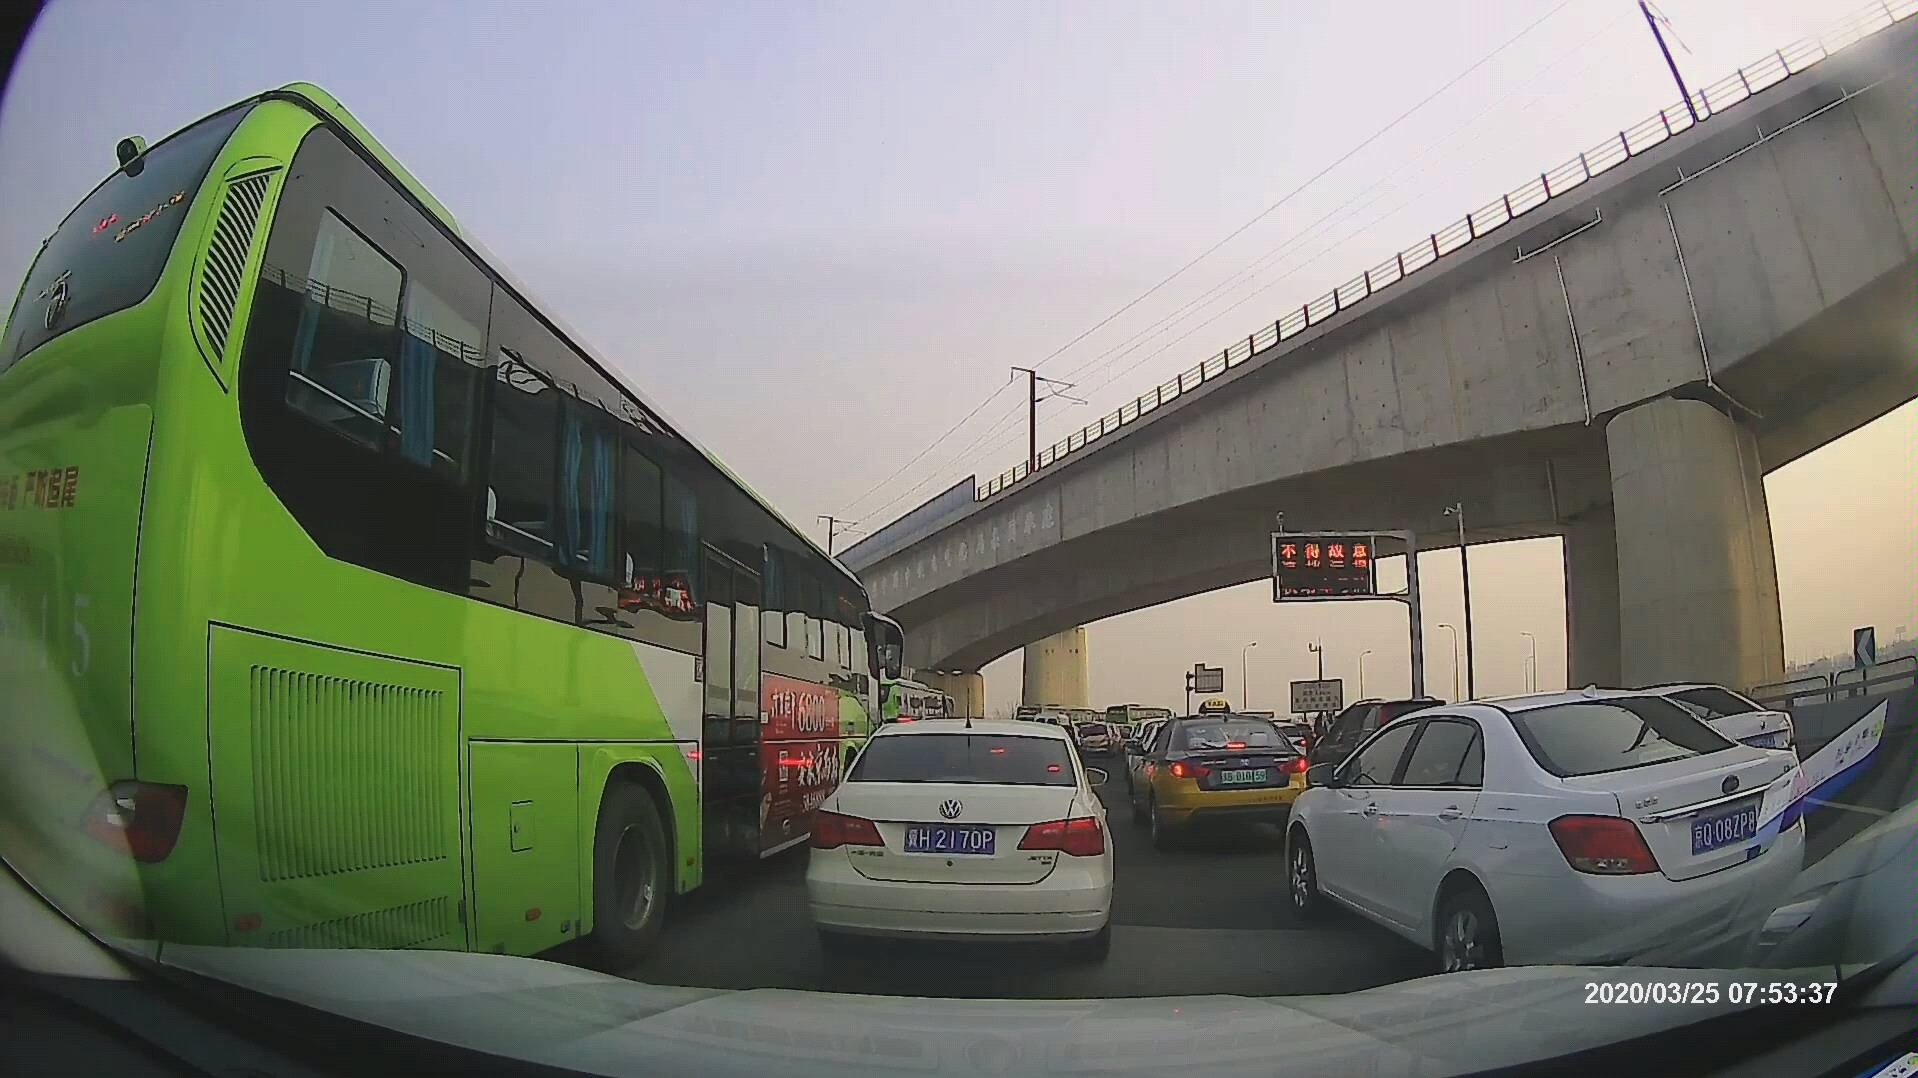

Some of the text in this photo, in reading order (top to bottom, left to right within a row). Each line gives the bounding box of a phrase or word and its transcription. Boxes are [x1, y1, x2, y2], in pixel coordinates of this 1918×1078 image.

[1280, 542, 1367, 559] 不得故意
[798, 692, 825, 732] 6800
